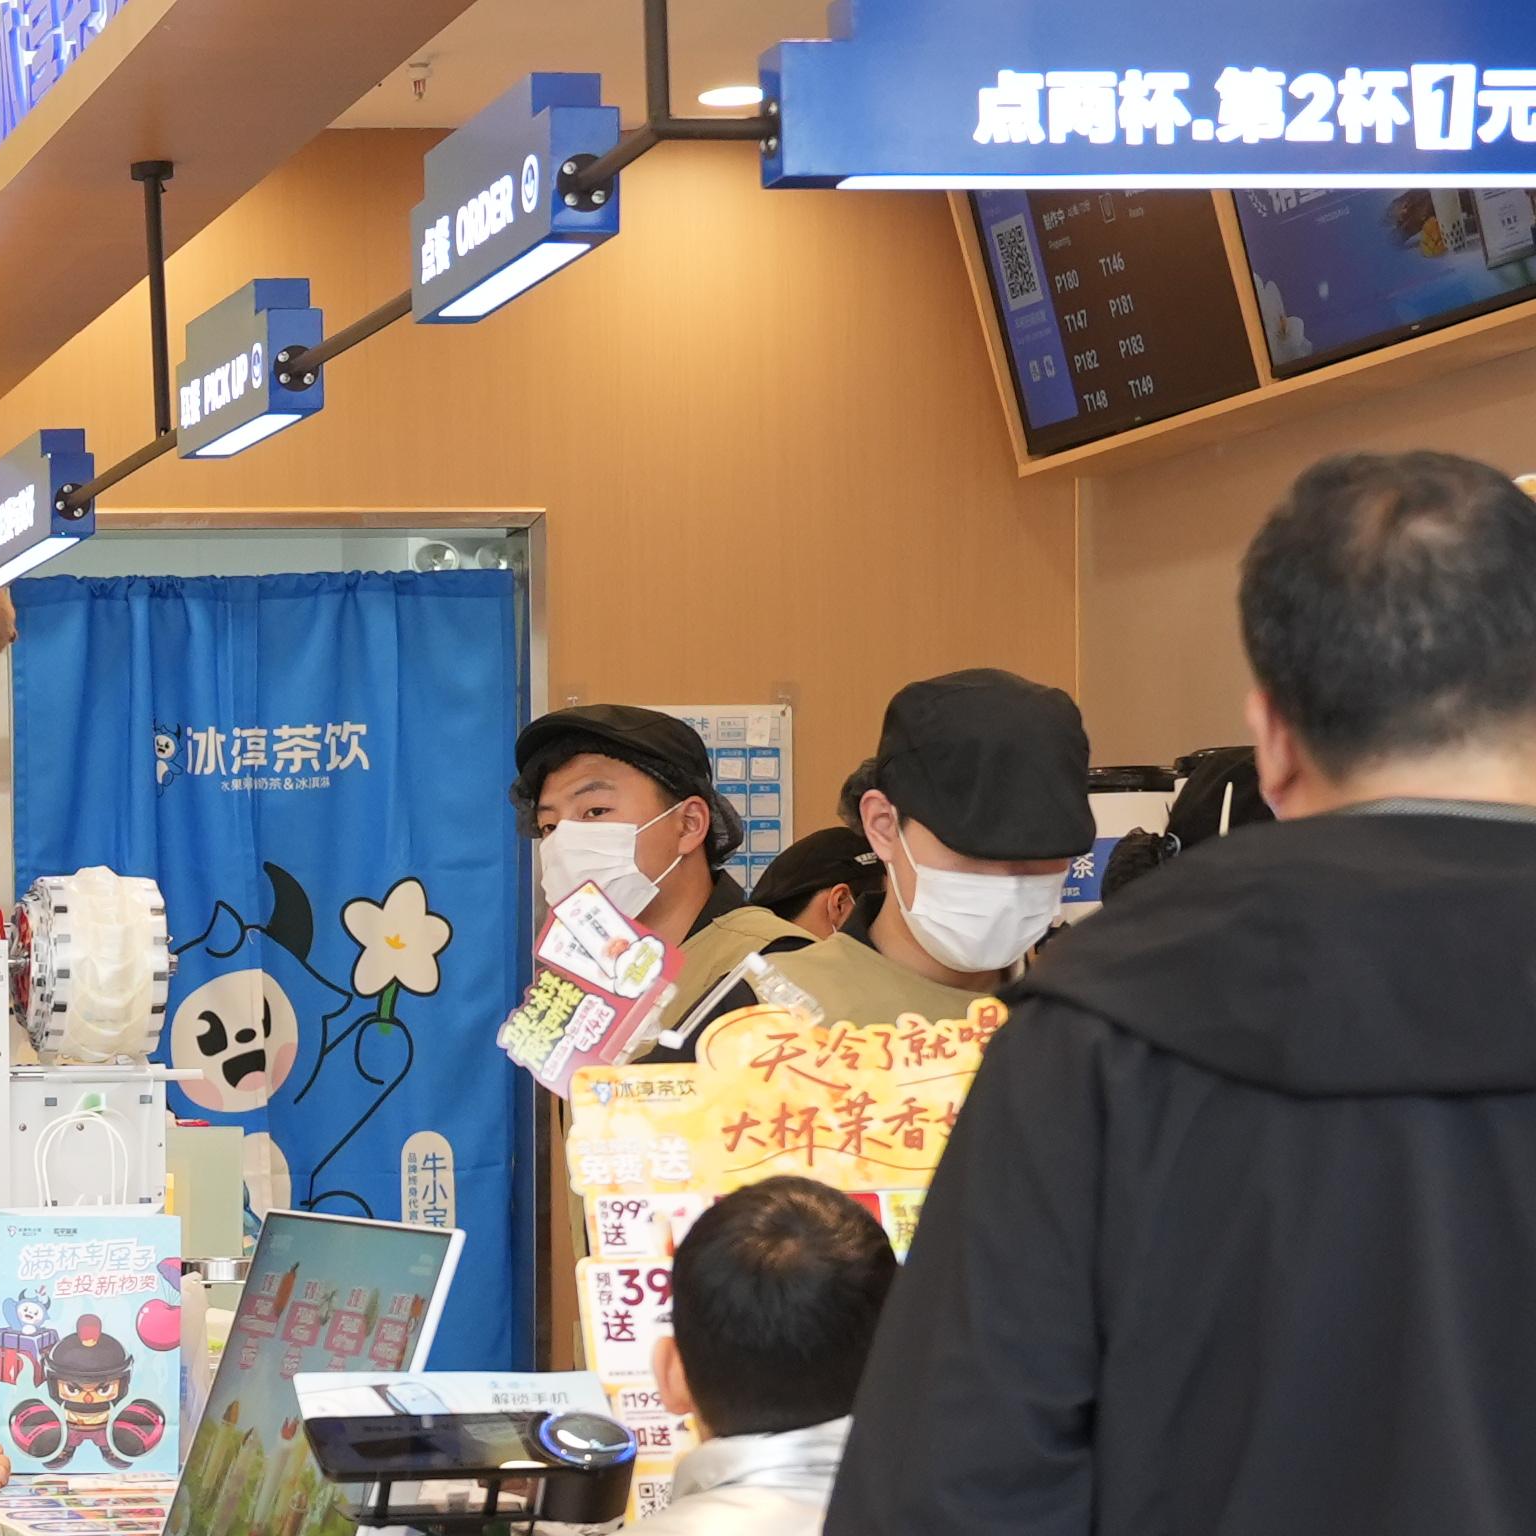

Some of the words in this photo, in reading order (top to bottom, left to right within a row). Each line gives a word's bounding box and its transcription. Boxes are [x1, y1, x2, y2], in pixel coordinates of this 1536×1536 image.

[456, 174, 513, 257] ORDER
[1099, 252, 1126, 277] T146
[1055, 270, 1079, 294] P180
[1109, 293, 1134, 318] P181
[1064, 309, 1088, 334] T147
[1119, 334, 1144, 359] P183
[1074, 350, 1099, 374] P182
[1128, 375, 1154, 399] T149
[1083, 389, 1109, 413] T148
[186, 720, 370, 776] 冰淳茶饮
[615, 1079, 697, 1098] 冰淳茶饮
[408, 1152, 419, 1224] 品牌终身代言
[421, 1152, 448, 1228] 牛小宝
[603, 1222, 628, 1246] 送
[19, 1239, 156, 1279] 满杯车厘子
[55, 1274, 157, 1297] 空投新物资
[602, 1309, 636, 1342] 送
